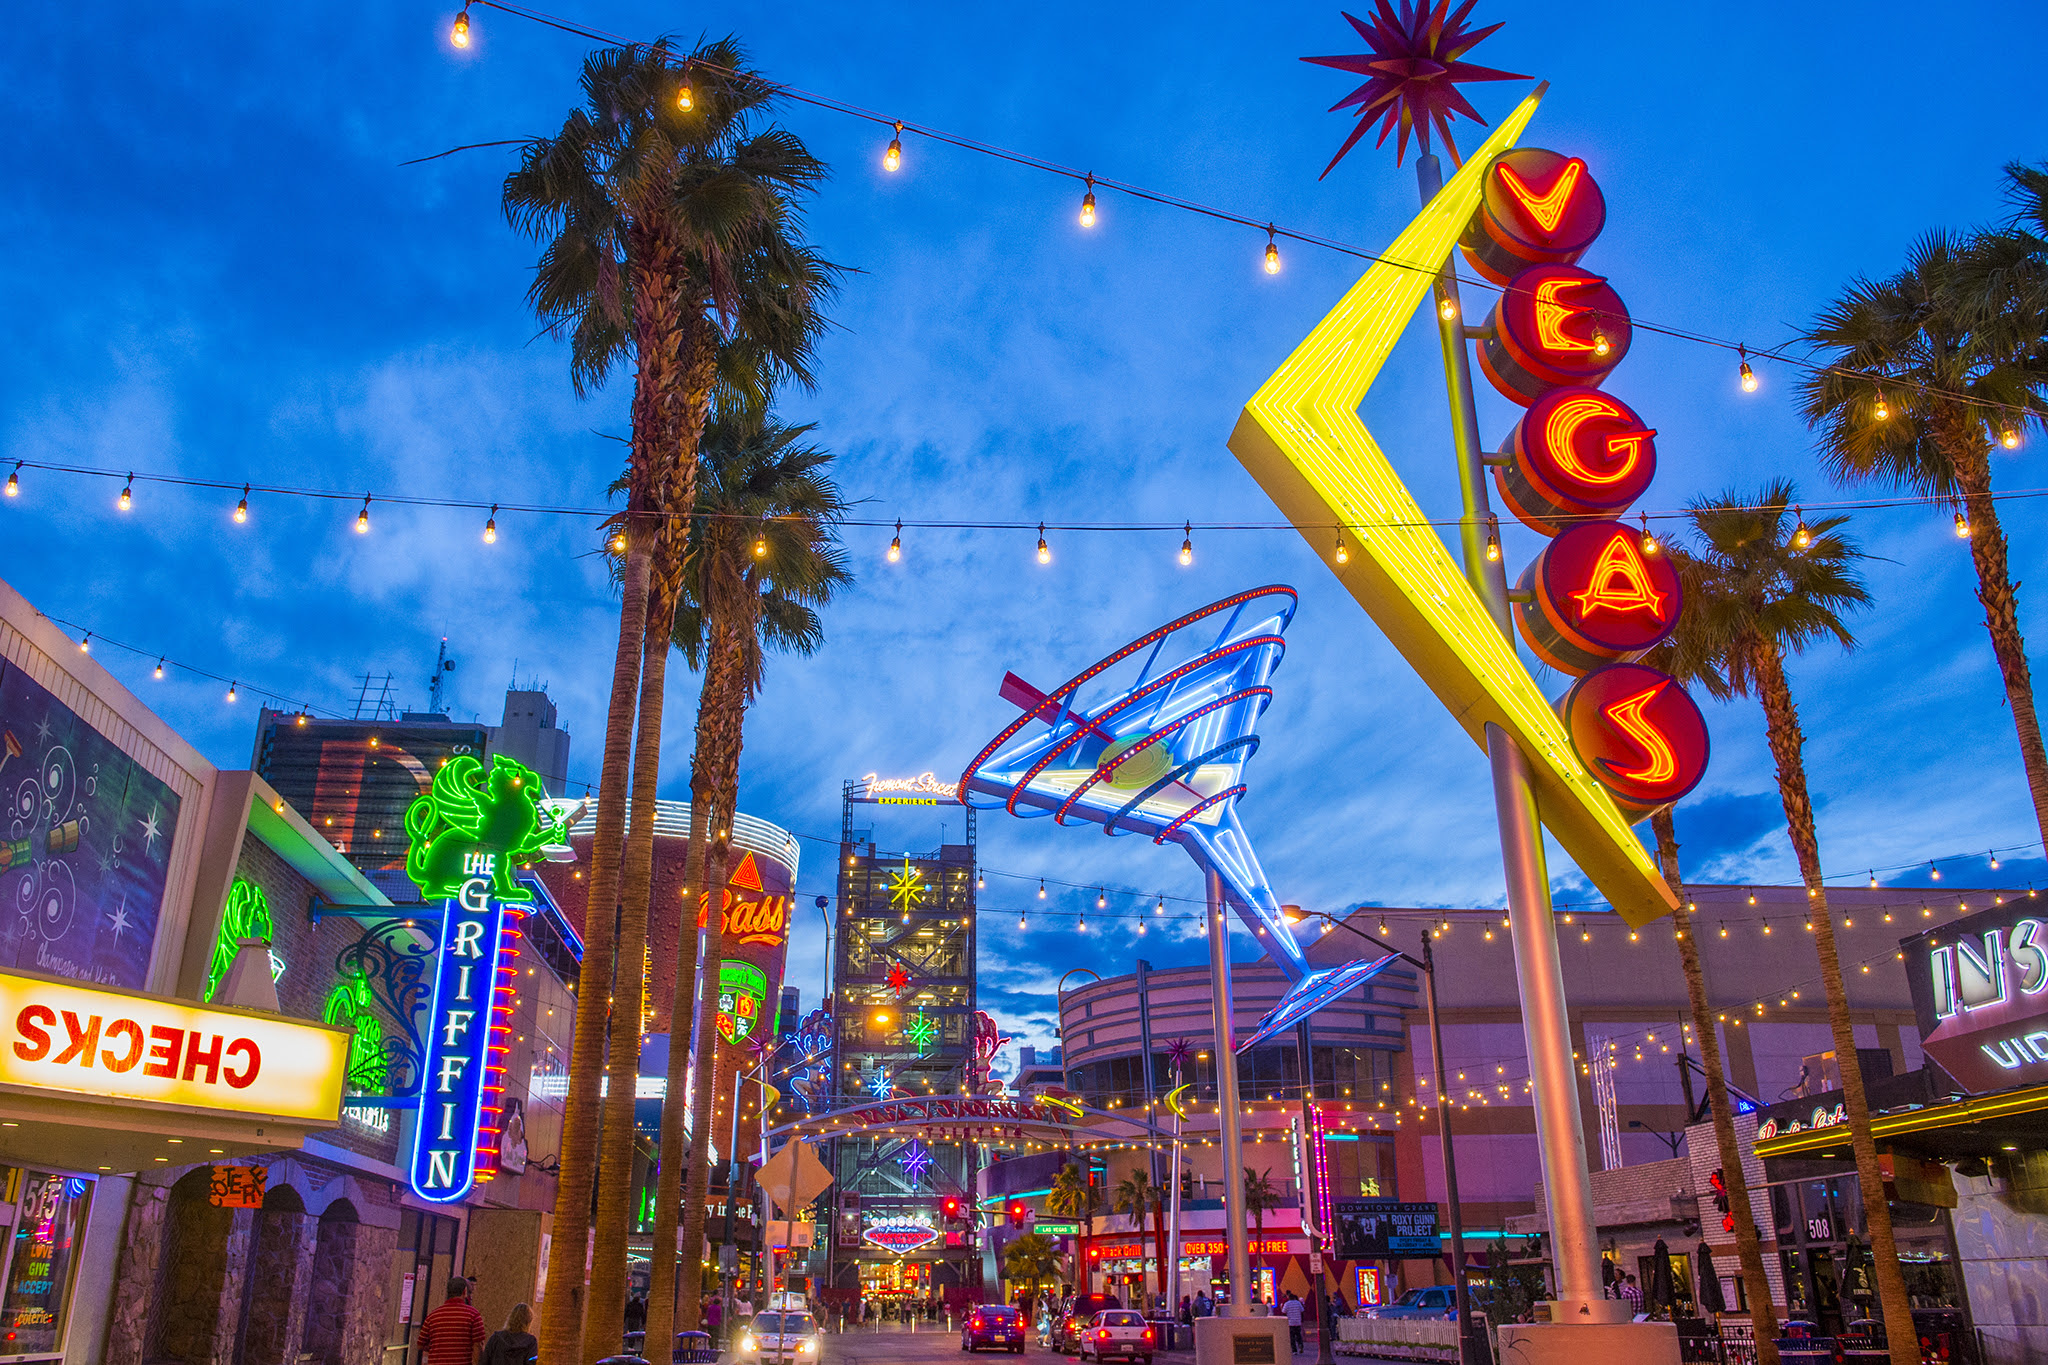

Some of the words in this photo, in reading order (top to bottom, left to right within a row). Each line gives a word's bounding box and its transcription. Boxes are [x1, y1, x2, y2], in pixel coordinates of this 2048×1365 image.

[1495, 156, 1677, 784] VEGAS
[862, 772, 916, 799] Fremont
[914, 771, 960, 797] Street
[878, 797, 937, 805] EXPERIENCE
[463, 852, 495, 875] THE
[422, 877, 493, 1190] GRIFFIN
[13, 1003, 262, 1089] CHECKS
[24, 1180, 61, 1219] 515
[1404, 1204, 1437, 1212] GRAND
[871, 1218, 931, 1226] WELCOME
[1391, 1215, 1412, 1225] ROXY
[1414, 1214, 1435, 1224] GUNN
[1397, 1226, 1432, 1235] PROJECT
[1808, 1218, 1829, 1239] 508
[1123, 1245, 1142, 1257] Grill
[1185, 1243, 1206, 1254] OVER
[1207, 1242, 1224, 1254] 350
[1266, 1241, 1288, 1252] FREE
[28, 1262, 50, 1277] GIVE
[18, 1280, 53, 1295] ACCEPT
[18, 1313, 49, 1325] coterie
